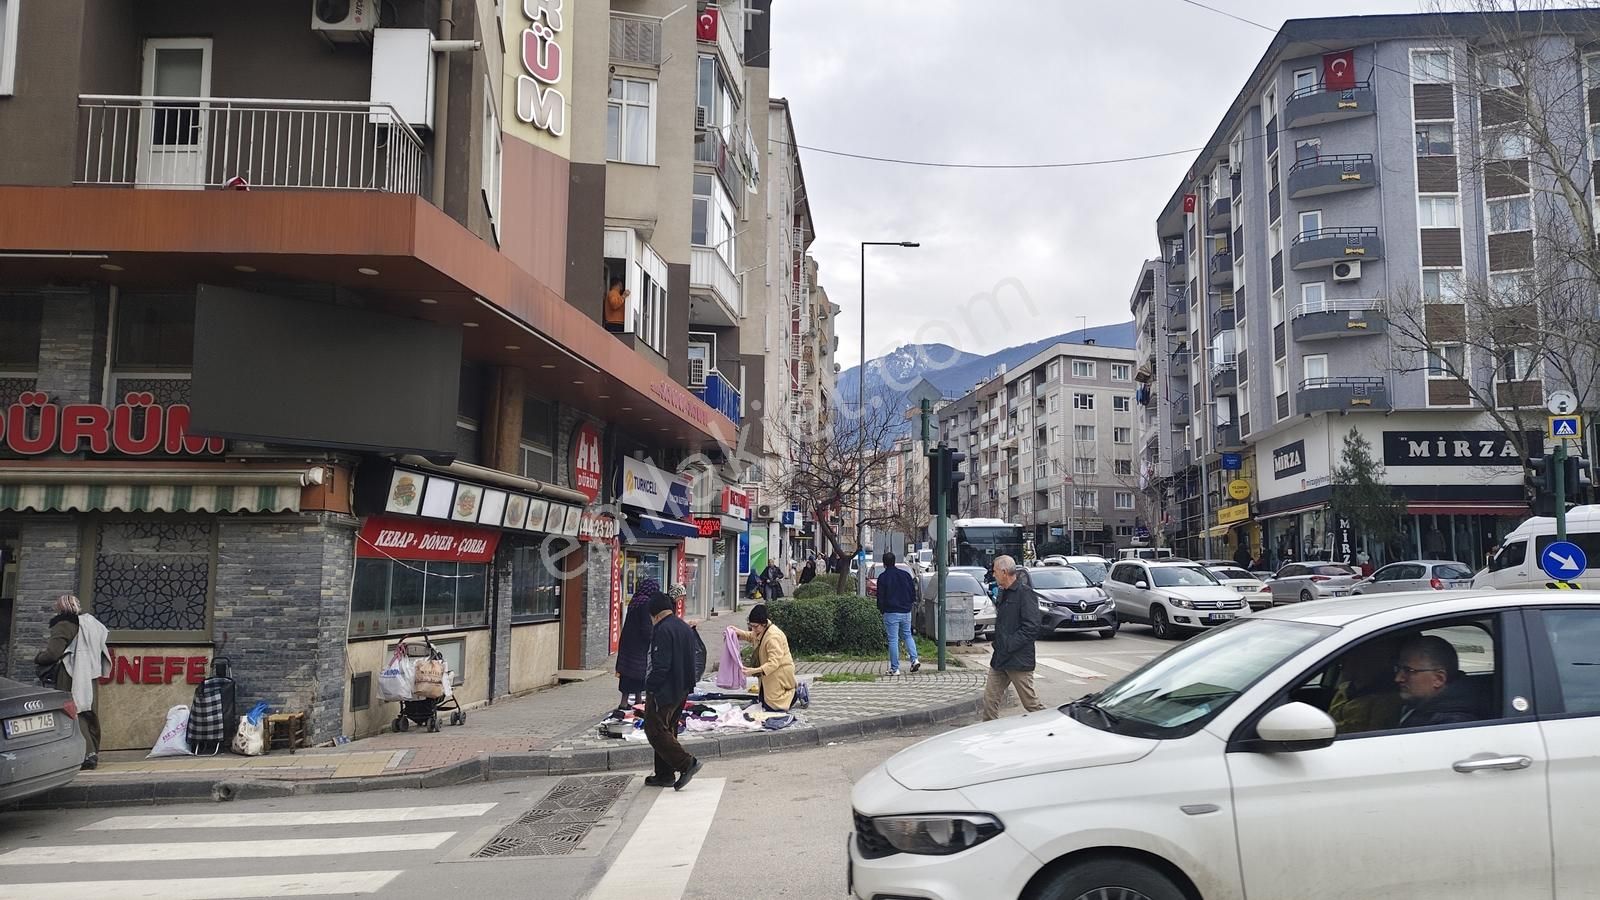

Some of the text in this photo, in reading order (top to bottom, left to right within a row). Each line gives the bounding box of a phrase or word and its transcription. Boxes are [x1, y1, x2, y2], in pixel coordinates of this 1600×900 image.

[0, 391, 225, 454] ÜRÜM
[1408, 436, 1521, 458] MİRZA
[1274, 450, 1302, 473] MİRZA
[577, 472, 598, 490] DÜRÜM
[634, 475, 658, 495] TURKCELL
[374, 529, 487, 557] KEBAP DÖNER ÇORBA
[612, 558, 620, 642] vodafone
[10, 720, 20, 733] 16
[23, 718, 33, 731] TT
[38, 714, 53, 729] 745
